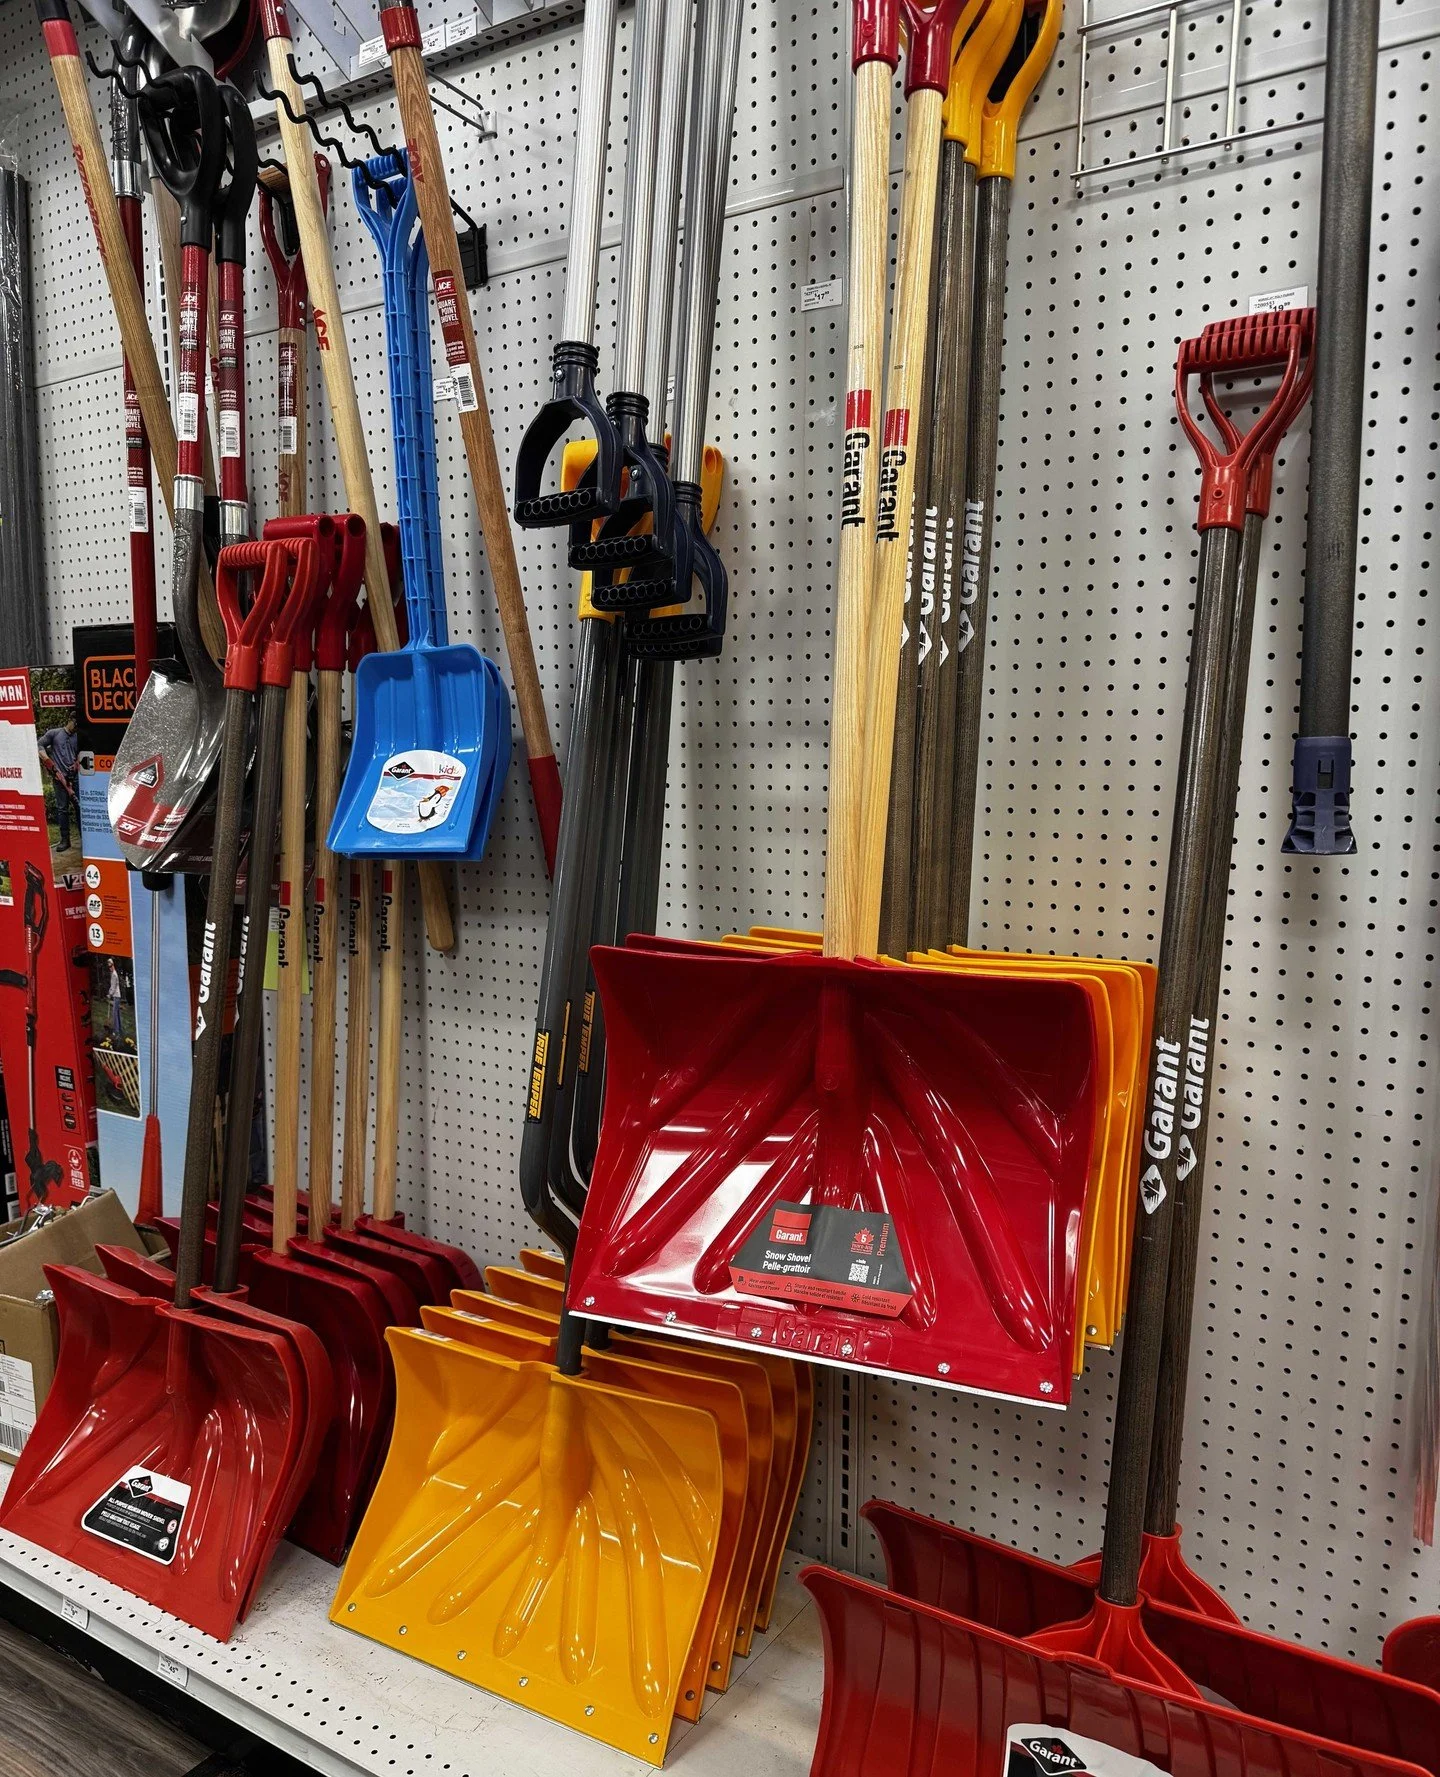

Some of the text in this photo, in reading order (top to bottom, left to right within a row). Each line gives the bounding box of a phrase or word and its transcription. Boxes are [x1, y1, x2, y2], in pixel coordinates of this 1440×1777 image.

[438, 281, 452, 290] ACE
[313, 305, 331, 351] ACE
[841, 431, 870, 530] Garant
[876, 449, 907, 544] Garant
[961, 498, 984, 605] Garant
[43, 694, 76, 703] CRAFTS
[91, 667, 137, 688] BLAC
[92, 690, 138, 711] DECK
[99, 759, 113, 768] CO
[87, 871, 98, 880] 4.4
[91, 928, 100, 938] 13
[278, 908, 291, 968] Garant
[313, 904, 325, 963] Garant
[349, 899, 361, 956] Garant
[380, 895, 392, 951] Garant
[198, 919, 216, 1004] Garant
[579, 991, 594, 1072] TRUE TEMPER
[529, 1032, 547, 1118] TRUE TEMPER
[1181, 1014, 1209, 1130] Garant
[1145, 1036, 1181, 1160] Garant
[72, 1177, 84, 1188] FEED
[765, 1250, 812, 1263] Snow Shovel
[776, 1229, 804, 1242] Garant
[877, 1223, 889, 1256] Premium
[762, 1261, 811, 1274] Pelle-grattoir
[775, 1314, 871, 1361] Garant
[1029, 1740, 1078, 1768] Garant
